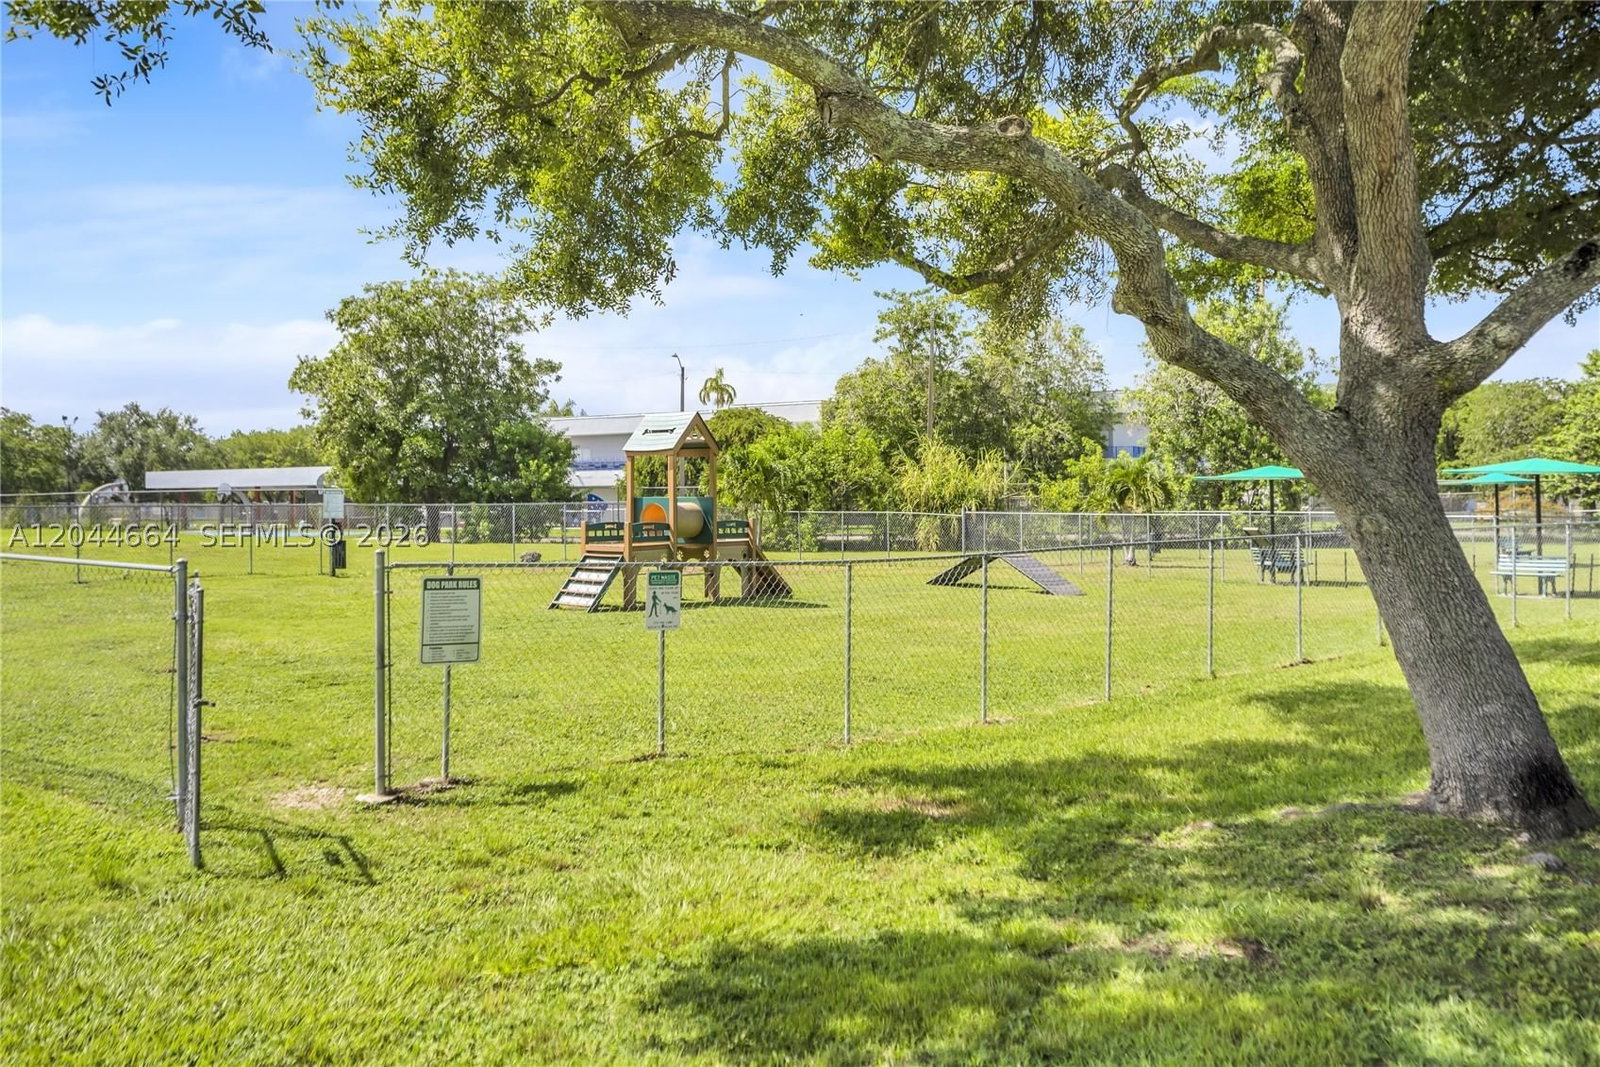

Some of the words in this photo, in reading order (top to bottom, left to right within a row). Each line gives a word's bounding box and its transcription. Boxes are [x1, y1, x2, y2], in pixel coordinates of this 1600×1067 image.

[426, 580, 440, 589] DOG
[441, 580, 458, 589] PARK
[458, 580, 477, 589] RULES
